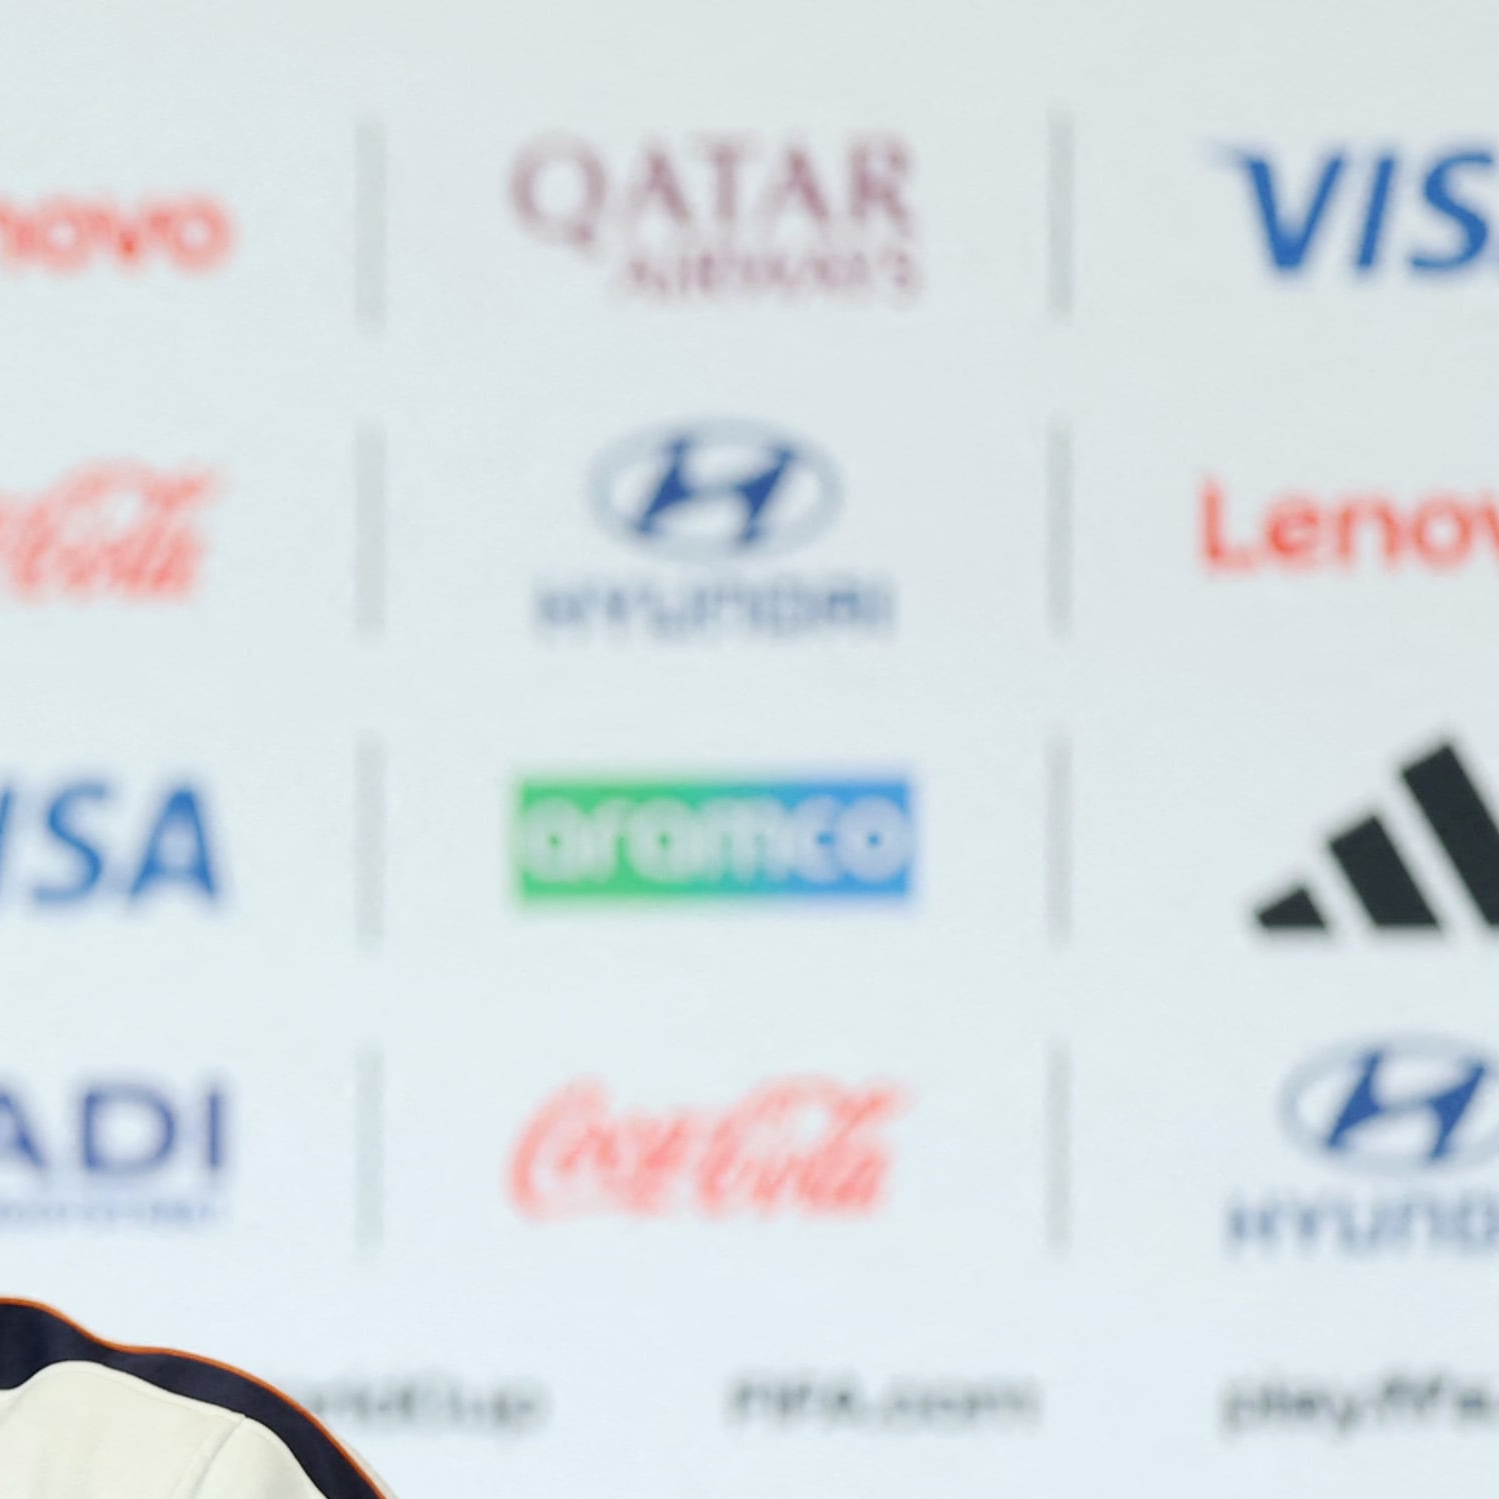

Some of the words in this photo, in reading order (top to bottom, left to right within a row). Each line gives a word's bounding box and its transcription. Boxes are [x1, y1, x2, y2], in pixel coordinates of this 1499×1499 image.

[506, 132, 912, 256] QATAR
[519, 797, 913, 886] aramco
[506, 1079, 901, 1217] Coca-Cola
